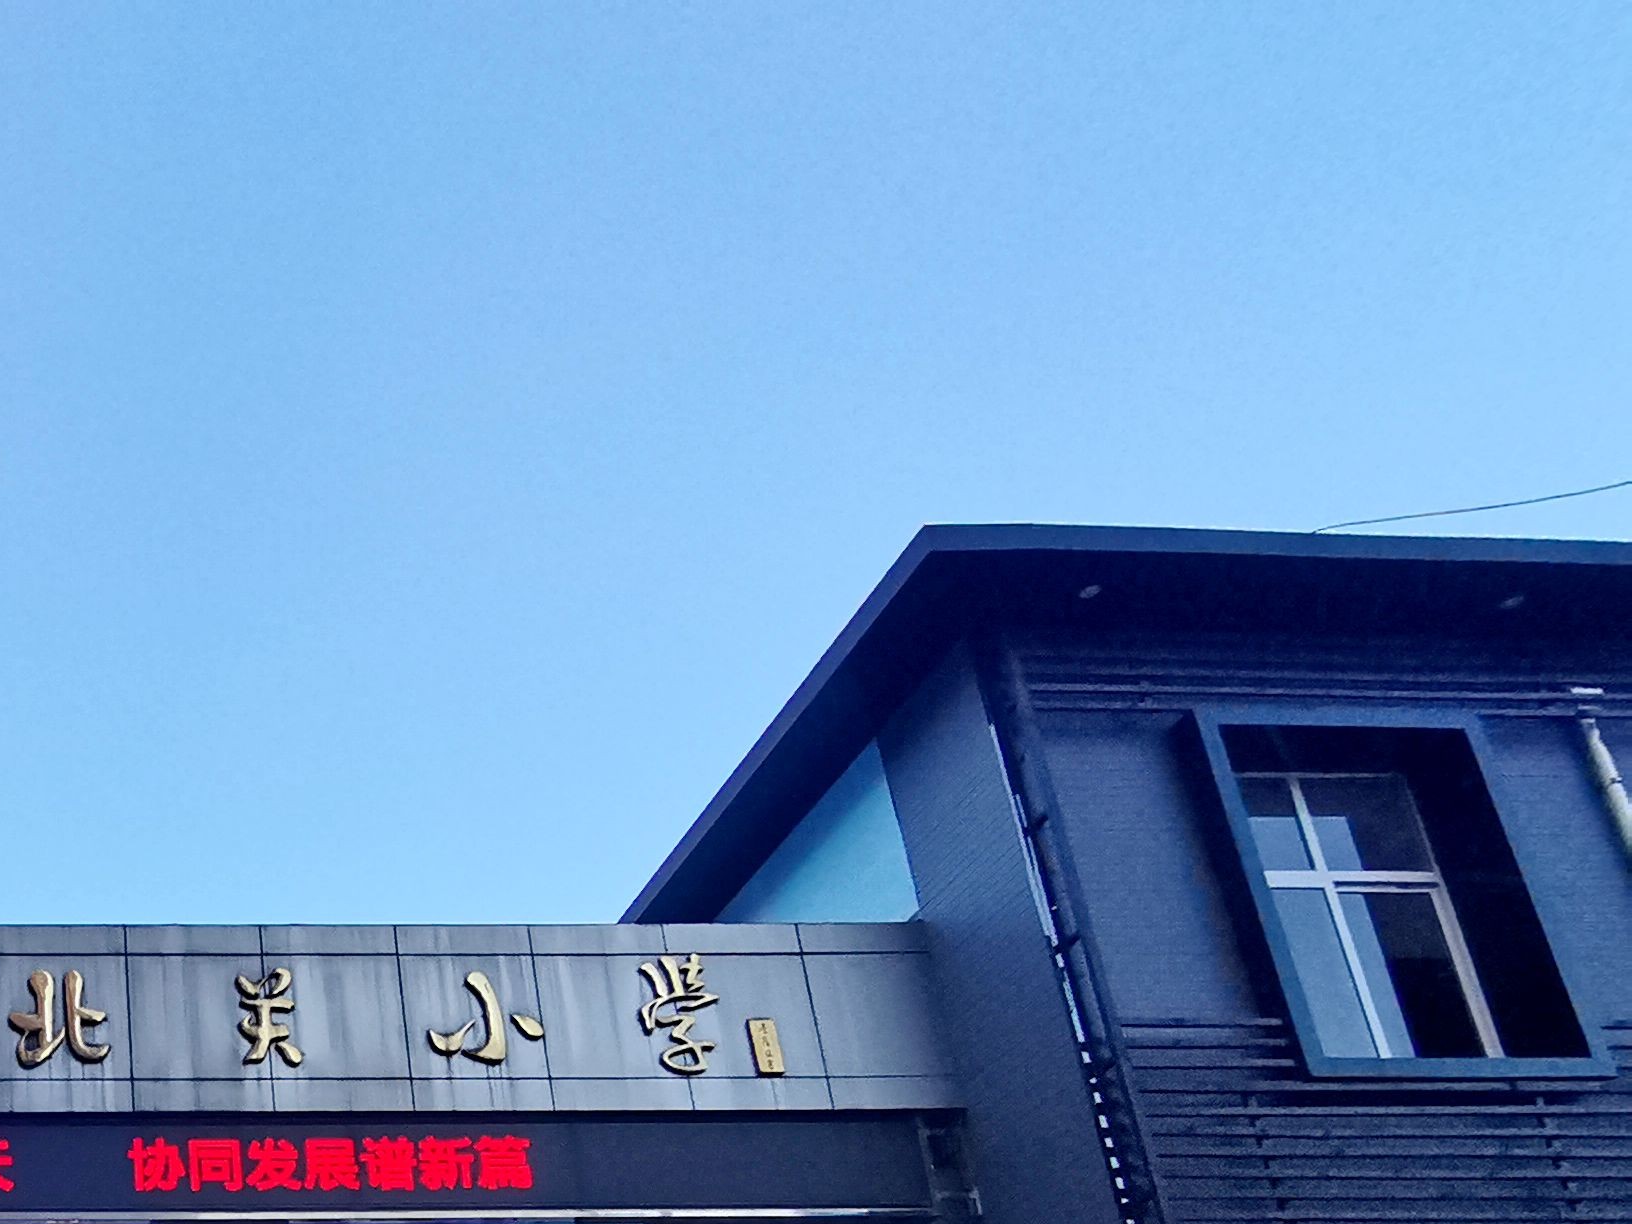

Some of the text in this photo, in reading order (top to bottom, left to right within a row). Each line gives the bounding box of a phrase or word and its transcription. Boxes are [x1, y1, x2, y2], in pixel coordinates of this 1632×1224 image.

[128, 1137, 533, 1193] 协同发展谱新篇
